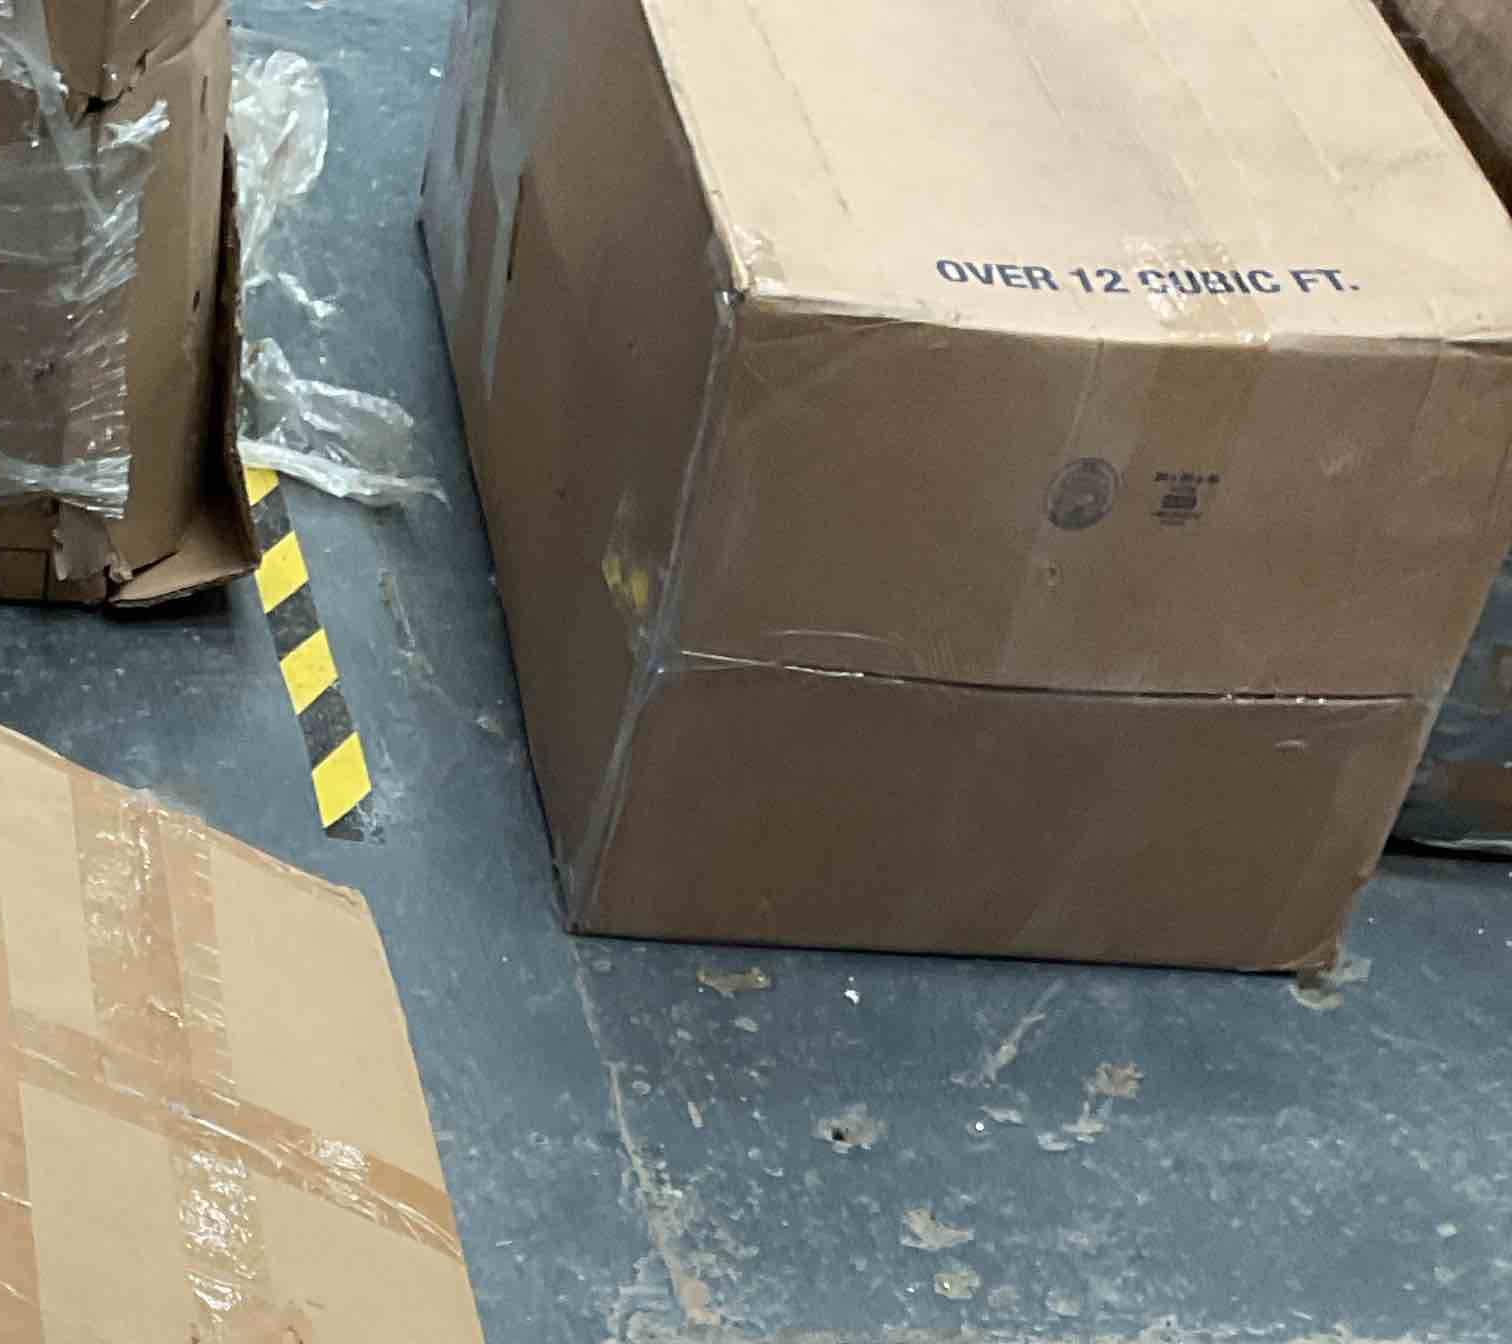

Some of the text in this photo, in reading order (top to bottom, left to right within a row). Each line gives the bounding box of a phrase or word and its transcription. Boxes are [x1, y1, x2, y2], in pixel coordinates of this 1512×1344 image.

[936, 259, 1361, 296] OVER 12 CUBIC FT.
